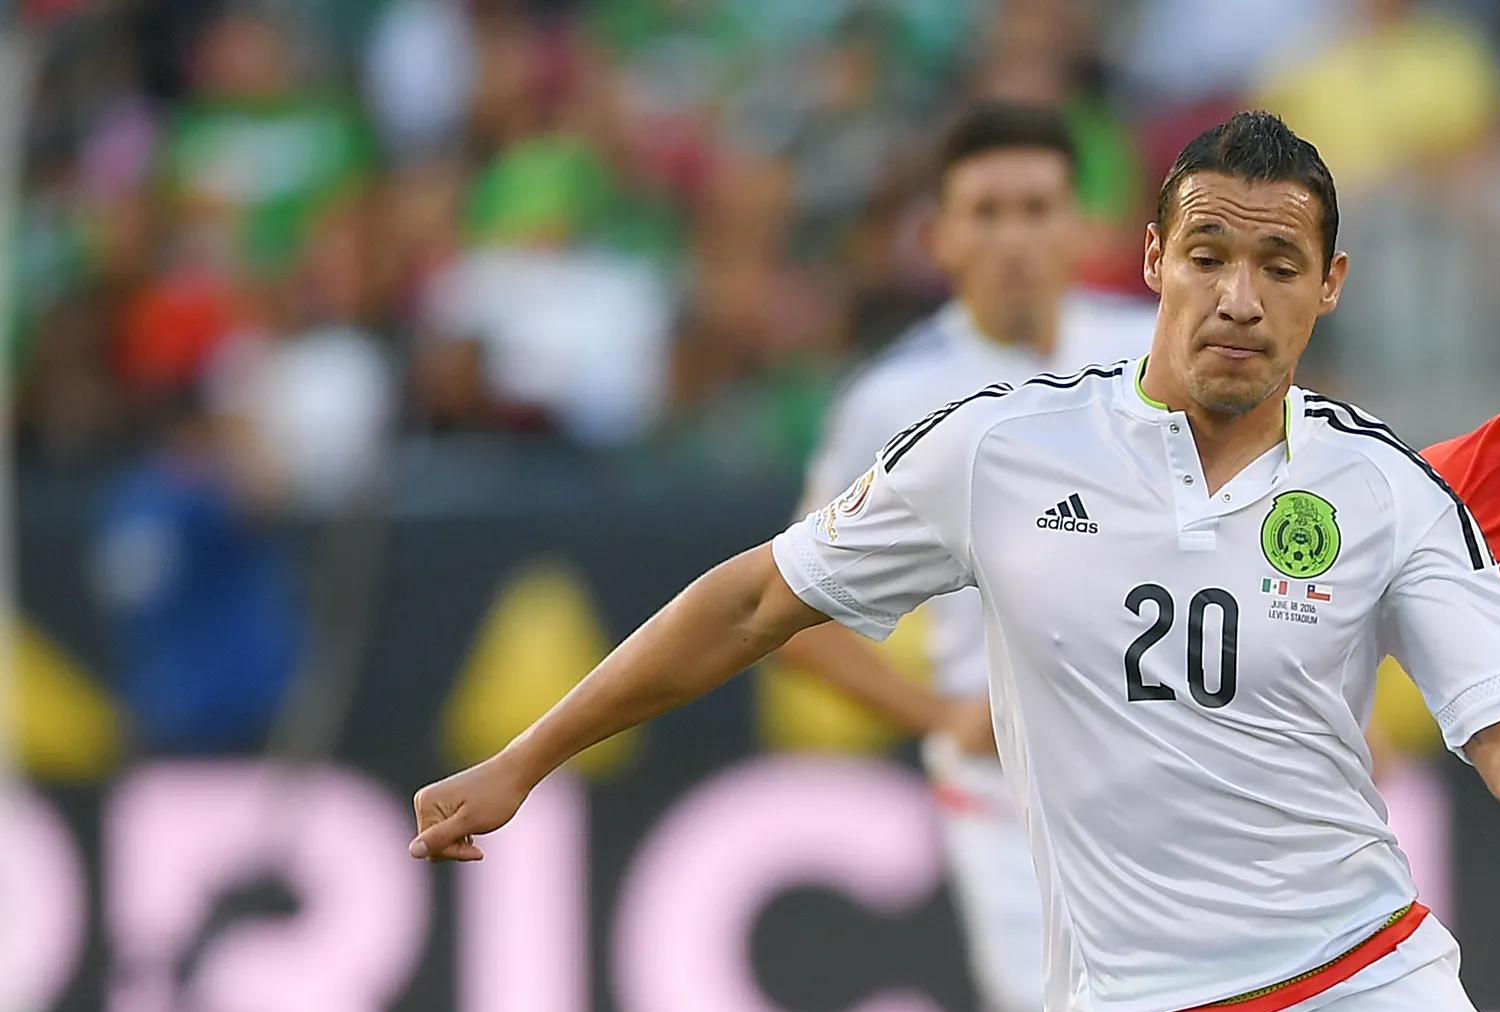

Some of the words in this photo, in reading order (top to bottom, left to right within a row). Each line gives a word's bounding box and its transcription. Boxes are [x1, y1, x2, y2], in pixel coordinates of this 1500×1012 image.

[1036, 515, 1098, 534] adidas
[1270, 600, 1288, 609] JUNE
[1300, 602, 1316, 614] 2016
[1290, 612, 1318, 624] STADIUM
[1124, 583, 1239, 707] 20
